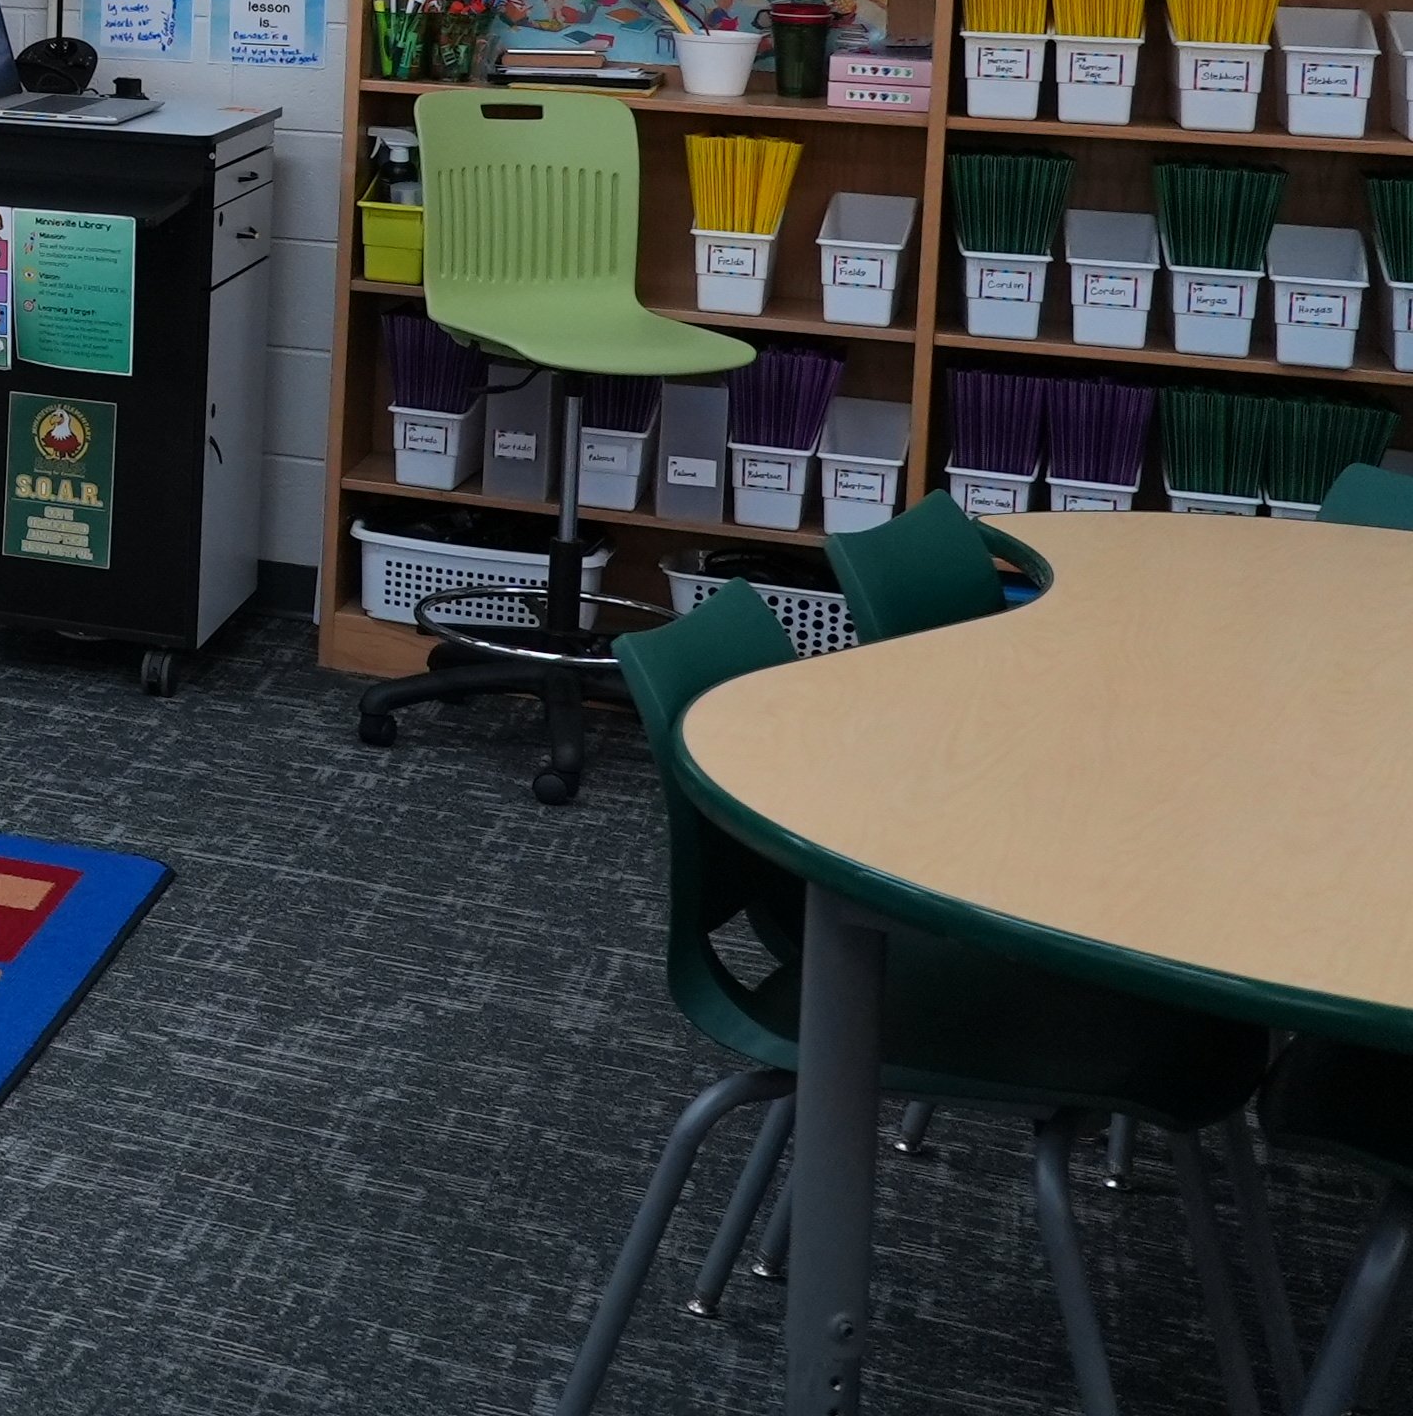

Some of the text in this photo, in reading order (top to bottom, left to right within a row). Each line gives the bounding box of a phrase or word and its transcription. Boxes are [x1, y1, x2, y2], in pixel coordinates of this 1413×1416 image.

[248, 1, 290, 13] lesson
[36, 217, 111, 231] Minnieville Library
[717, 256, 745, 266] Fields
[839, 267, 866, 277] Fields
[38, 304, 68, 315] Learning
[15, 473, 103, 507] S.O.A.R.
